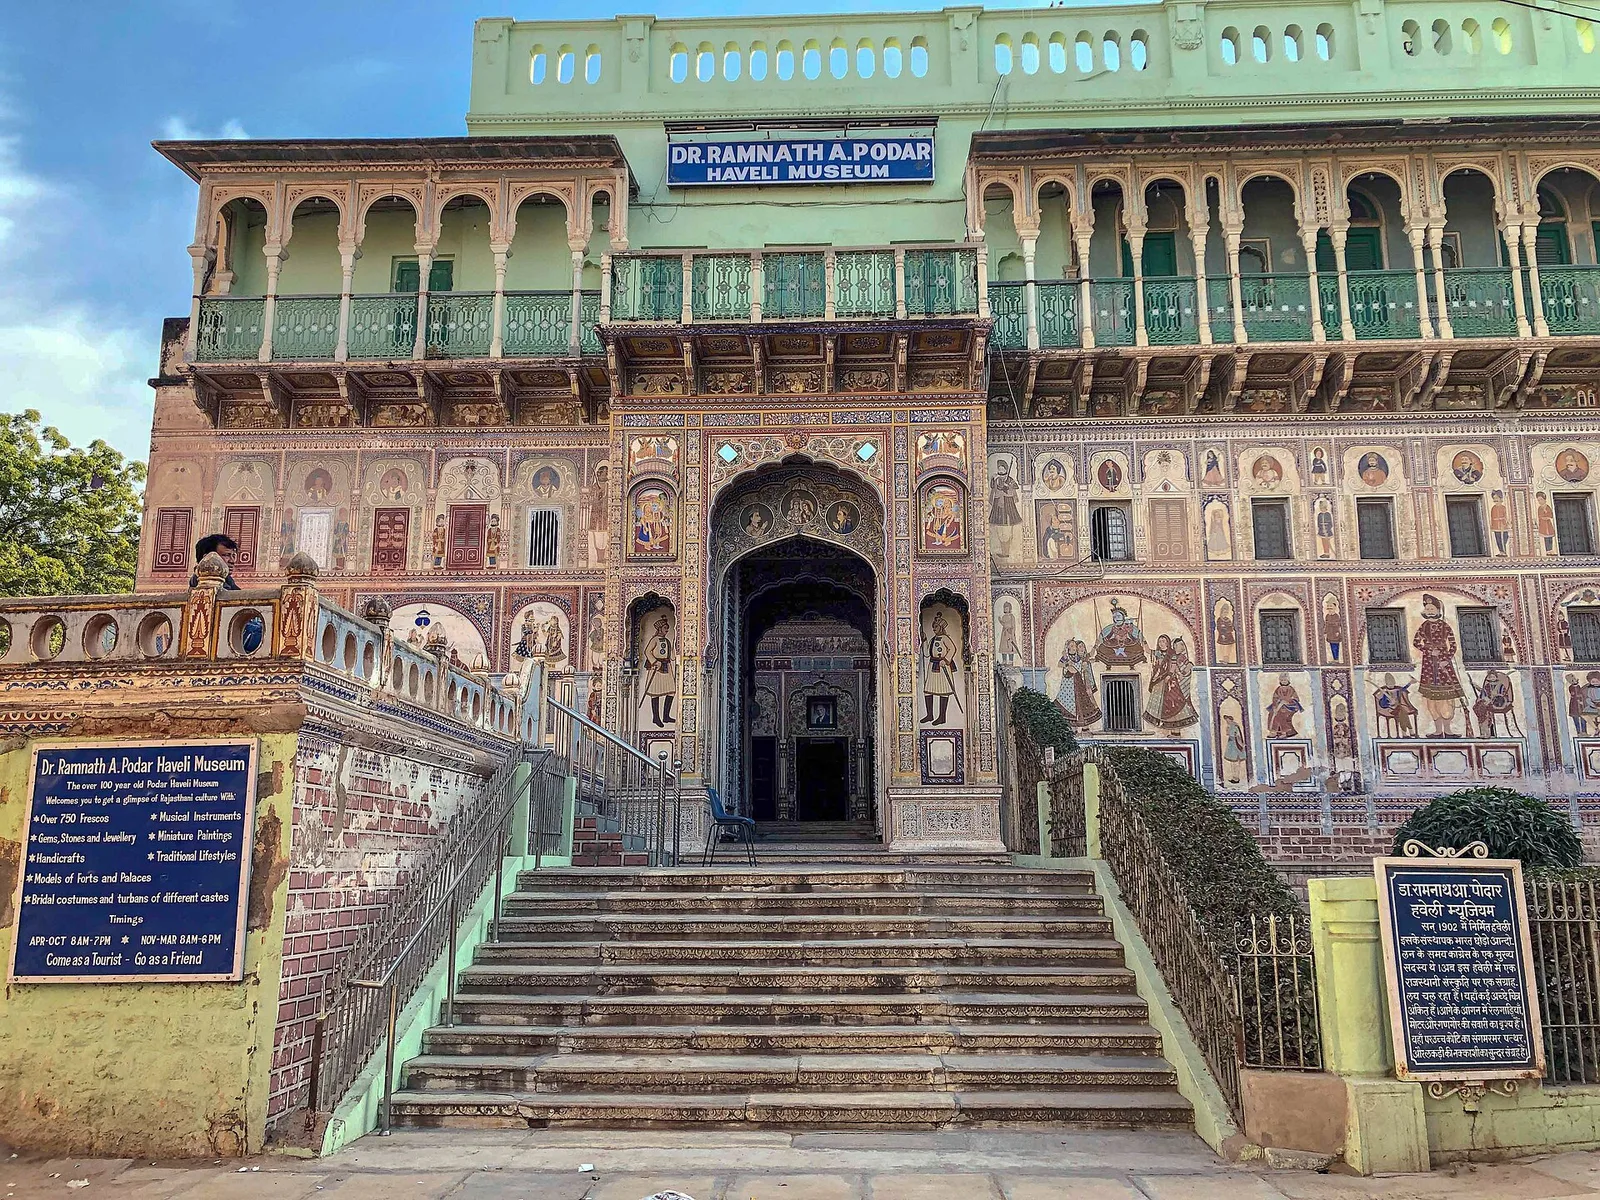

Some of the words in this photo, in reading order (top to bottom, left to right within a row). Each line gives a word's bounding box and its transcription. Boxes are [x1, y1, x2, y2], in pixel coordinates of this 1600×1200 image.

[707, 166, 778, 181] HAVELI
[788, 165, 889, 180] MUSEUM
[58, 758, 106, 774] Ramnath
[157, 756, 190, 772] Haveli
[194, 756, 245, 772] Museum
[67, 781, 81, 790] The
[82, 782, 98, 790] over
[100, 780, 113, 790] 100
[114, 782, 131, 792] year
[133, 780, 144, 788] old
[146, 780, 168, 788] Podar
[170, 779, 192, 788] Haveli
[193, 779, 218, 788] Museum
[46, 796, 78, 805] Welcomes
[80, 797, 92, 806] you
[94, 796, 102, 804] to
[102, 796, 114, 806] get
[123, 795, 150, 806] glimpse
[151, 794, 159, 803] of
[160, 793, 194, 804] Rajasthani
[194, 792, 218, 802] culture
[40, 814, 58, 824] Over
[60, 814, 76, 824] 750
[80, 814, 110, 823] Frescos
[160, 812, 190, 822] Musical
[194, 811, 242, 821] Instruments
[86, 832, 100, 842] and
[103, 832, 136, 845] Jewellery
[158, 831, 194, 841] Miniature
[197, 830, 232, 842] Paintings
[36, 854, 86, 864] Handicrafts
[156, 850, 197, 862] Traditional
[199, 850, 236, 863] Lifestyles
[34, 873, 62, 884] Models
[64, 873, 74, 884] of
[77, 873, 98, 884] Forts
[102, 872, 118, 883] and
[120, 872, 152, 882] Palaces
[32, 894, 54, 905] Bridal
[56, 894, 98, 904] costumes
[100, 894, 114, 904] and
[117, 893, 148, 904] turbans
[150, 892, 160, 903] of
[162, 892, 199, 902] different
[200, 893, 229, 902] castes
[1410, 899, 1445, 918] हवेली
[1446, 900, 1496, 920] म्यूजियम
[109, 914, 144, 926] Timings
[1490, 920, 1511, 933] हवेली
[29, 936, 67, 946] APR-OCT
[140, 934, 178, 945] NOV-MAR
[1454, 936, 1472, 946] भारत
[46, 953, 72, 966] Come
[92, 952, 122, 966] Tourist
[134, 952, 146, 966] Go
[148, 955, 160, 965] as
[161, 956, 167, 964] a
[170, 951, 202, 965] Friend
[1402, 950, 1415, 960] लन
[1416, 946, 1424, 959] के
[1426, 950, 1448, 960] समय
[1471, 947, 1480, 959] के
[1480, 950, 1494, 960] एक
[1403, 964, 1428, 973] सदस्य
[1456, 964, 1470, 974] इस
[1472, 960, 1493, 974] हवेली
[1502, 964, 1516, 974] एक
[1405, 975, 1441, 988] राजस्थानी
[1471, 978, 1482, 988] पर
[1482, 978, 1496, 988] एक
[1422, 992, 1436, 1003] चल
[1438, 992, 1451, 1003] रहा
[1489, 1020, 1498, 1029] का
